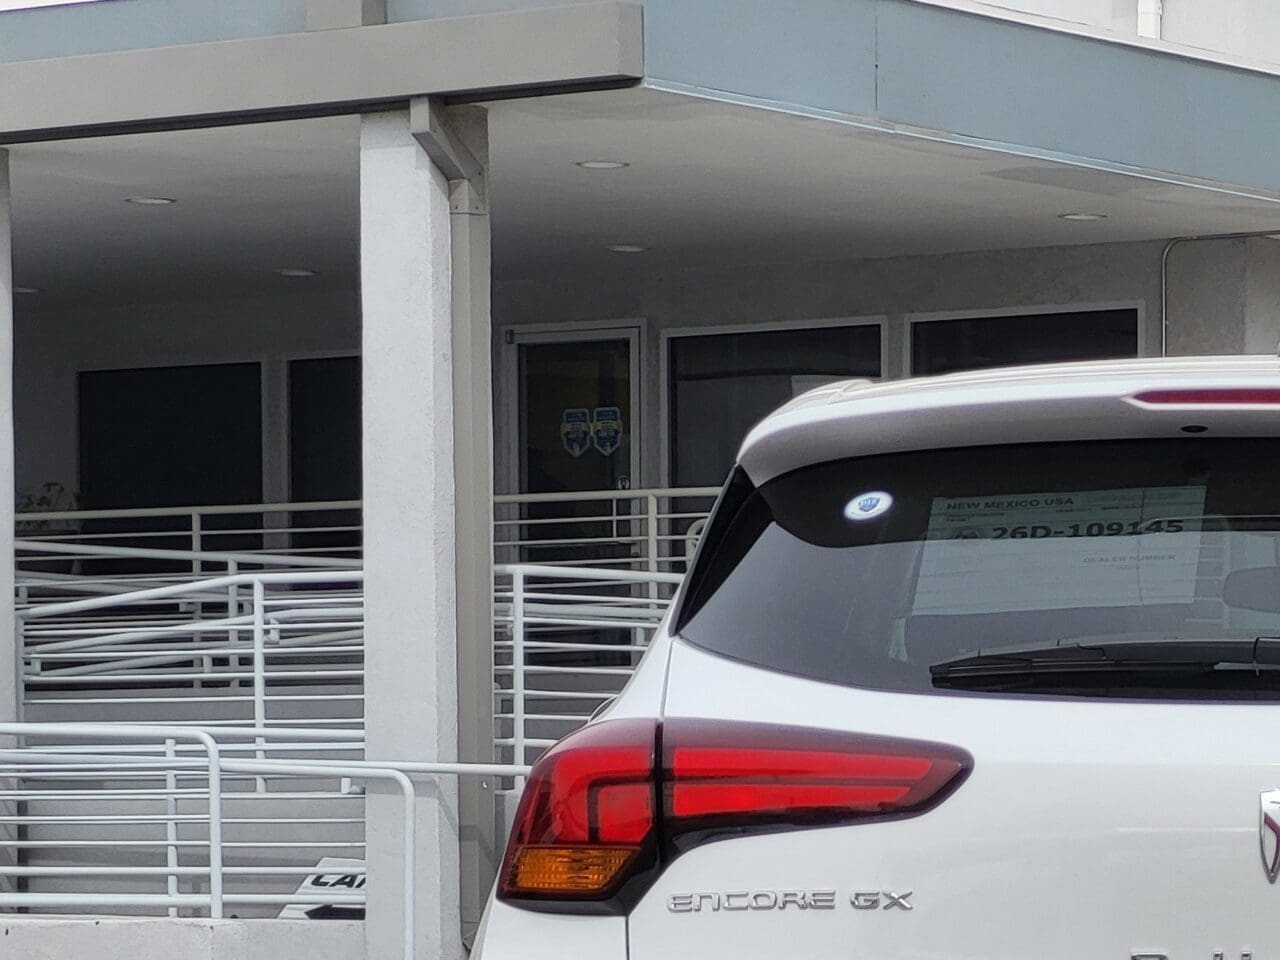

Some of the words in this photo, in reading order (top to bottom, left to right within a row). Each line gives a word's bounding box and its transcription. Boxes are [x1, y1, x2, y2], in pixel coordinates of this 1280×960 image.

[947, 501, 980, 511] NEW
[984, 499, 1040, 509] MEXICO
[1044, 497, 1074, 506] USA
[991, 519, 1184, 541] 26D-109145
[666, 889, 836, 913] ENCORE
[849, 889, 914, 912] GX
